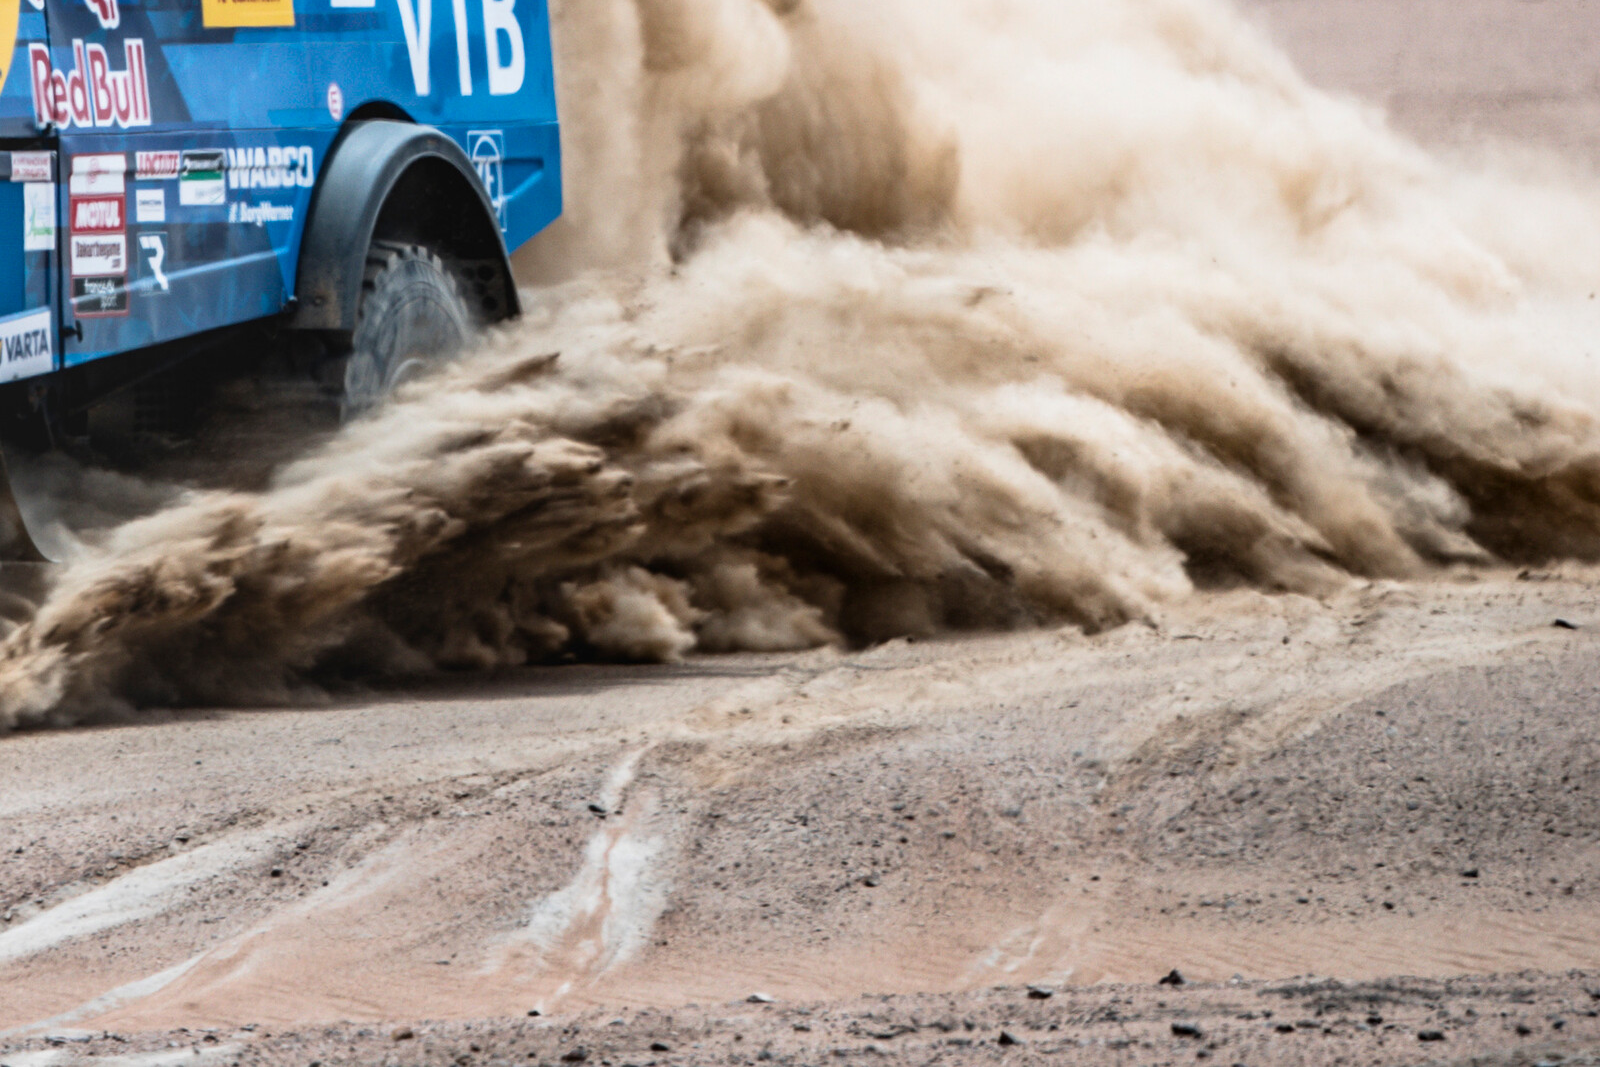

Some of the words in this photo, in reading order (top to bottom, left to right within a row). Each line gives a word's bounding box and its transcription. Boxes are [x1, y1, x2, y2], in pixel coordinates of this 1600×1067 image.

[30, 41, 92, 127] Red
[87, 41, 150, 125] Bull
[228, 146, 315, 189] WABCO
[75, 201, 121, 228] MOTUL
[240, 200, 294, 228] BorgWarner
[5, 328, 49, 362] VARTA
